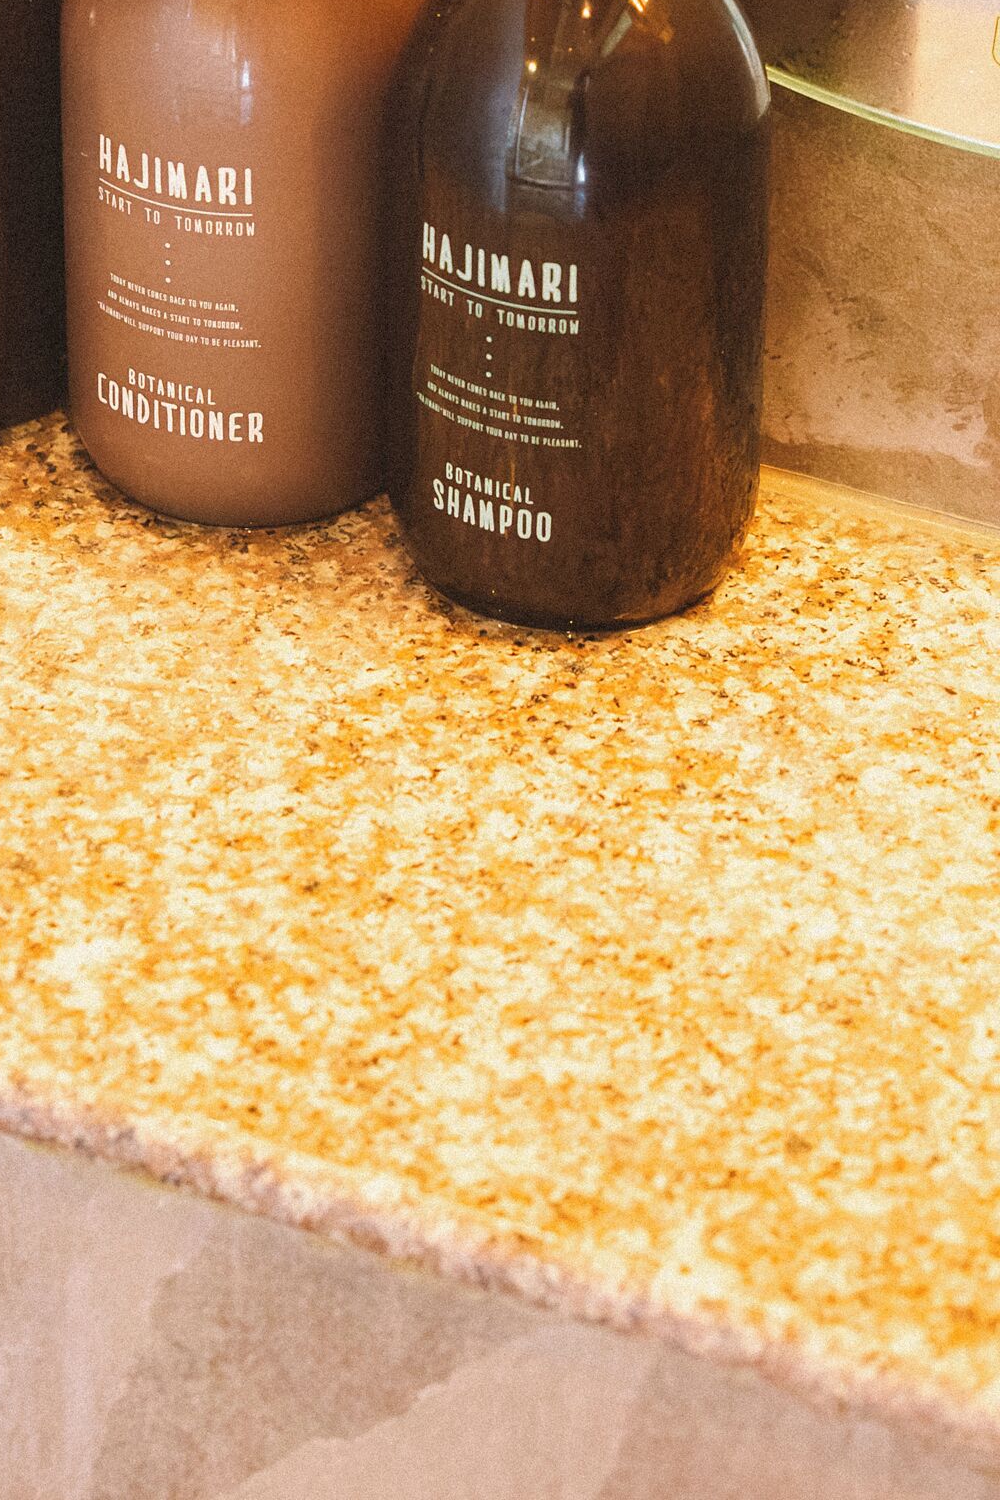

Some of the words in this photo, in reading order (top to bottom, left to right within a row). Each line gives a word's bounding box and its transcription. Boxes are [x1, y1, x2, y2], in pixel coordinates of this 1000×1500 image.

[100, 134, 252, 206] HAJIMARI
[99, 186, 132, 215] START
[144, 208, 160, 225] TO
[175, 216, 255, 237] TOMORROW
[423, 222, 578, 303] HAJIMARI
[108, 289, 117, 301] AND
[119, 296, 140, 311] ALWAYS
[142, 305, 161, 318] MAKES
[164, 311, 168, 320] A
[170, 314, 190, 325] START
[193, 318, 201, 327] TO
[128, 281, 145, 296] NEVER
[148, 289, 167, 302] COMES
[170, 296, 186, 306] BACK
[189, 300, 197, 308] TO
[200, 301, 212, 310] YOU
[421, 275, 455, 307] START
[467, 299, 483, 318] TO
[497, 309, 579, 335] TOMORROW
[124, 316, 136, 327] WILL
[138, 322, 164, 337] SUPPORT
[167, 331, 184, 342] YOUR
[186, 334, 198, 344] DAY
[201, 337, 209, 345] TO
[212, 338, 221, 347] BE
[98, 373, 264, 443] CONDITIONER
[129, 367, 216, 406] BOTANICAL
[427, 381, 437, 393] AND
[438, 388, 459, 404] ALWAYS
[461, 399, 481, 413] MAKES
[483, 406, 487, 415] A
[490, 409, 510, 421] START
[513, 414, 521, 424] TO
[448, 373, 465, 388] NEVER
[467, 382, 488, 397] COMES
[490, 390, 506, 402] BACK
[509, 394, 517, 404] TO
[520, 397, 533, 407] YOU
[443, 409, 455, 422] WILL
[457, 415, 484, 432] SUPPORT
[486, 426, 502, 438] YOUR
[505, 431, 517, 441] DAY
[520, 434, 529, 443] TO
[532, 436, 540, 445] BE
[446, 462, 534, 505] BOTANICAL
[433, 478, 552, 542] SHAMPOO
